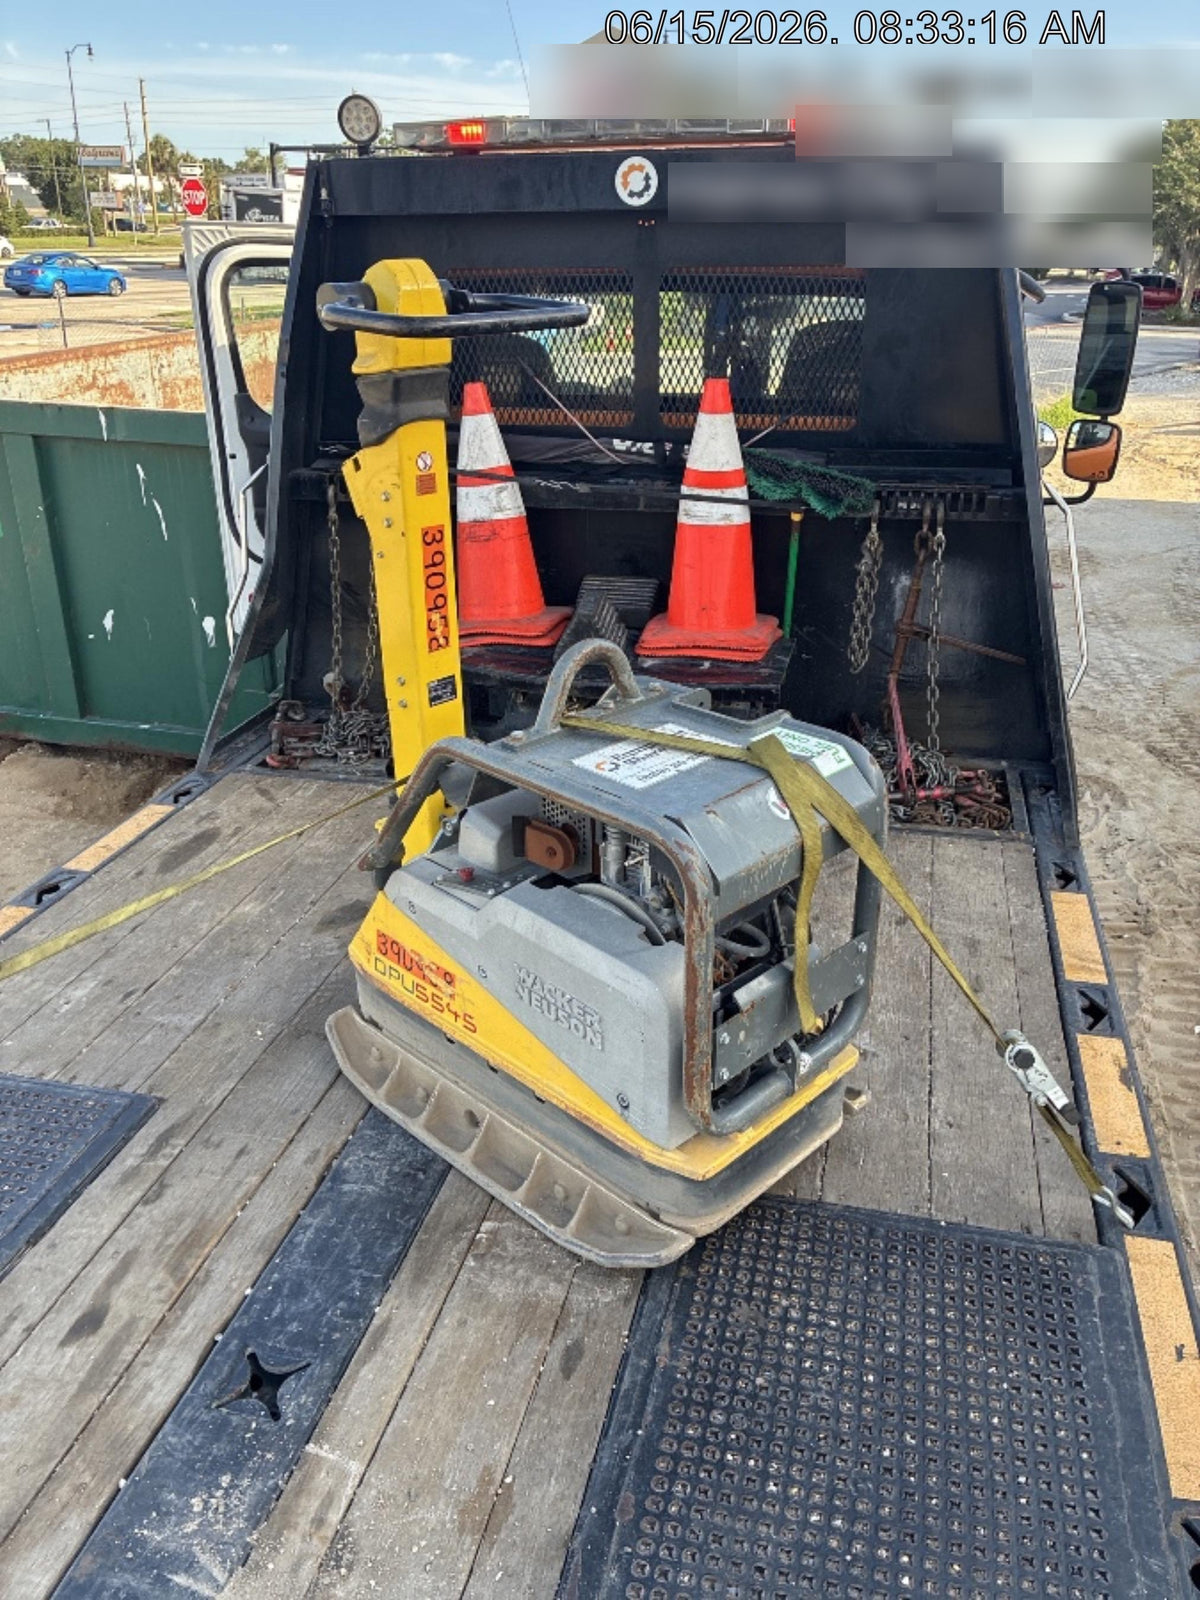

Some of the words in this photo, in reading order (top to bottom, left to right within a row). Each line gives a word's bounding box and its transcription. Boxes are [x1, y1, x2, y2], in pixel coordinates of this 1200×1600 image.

[184, 190, 205, 205] STOP
[514, 961, 602, 1029] WACKER
[515, 979, 605, 1051] NEUSON
